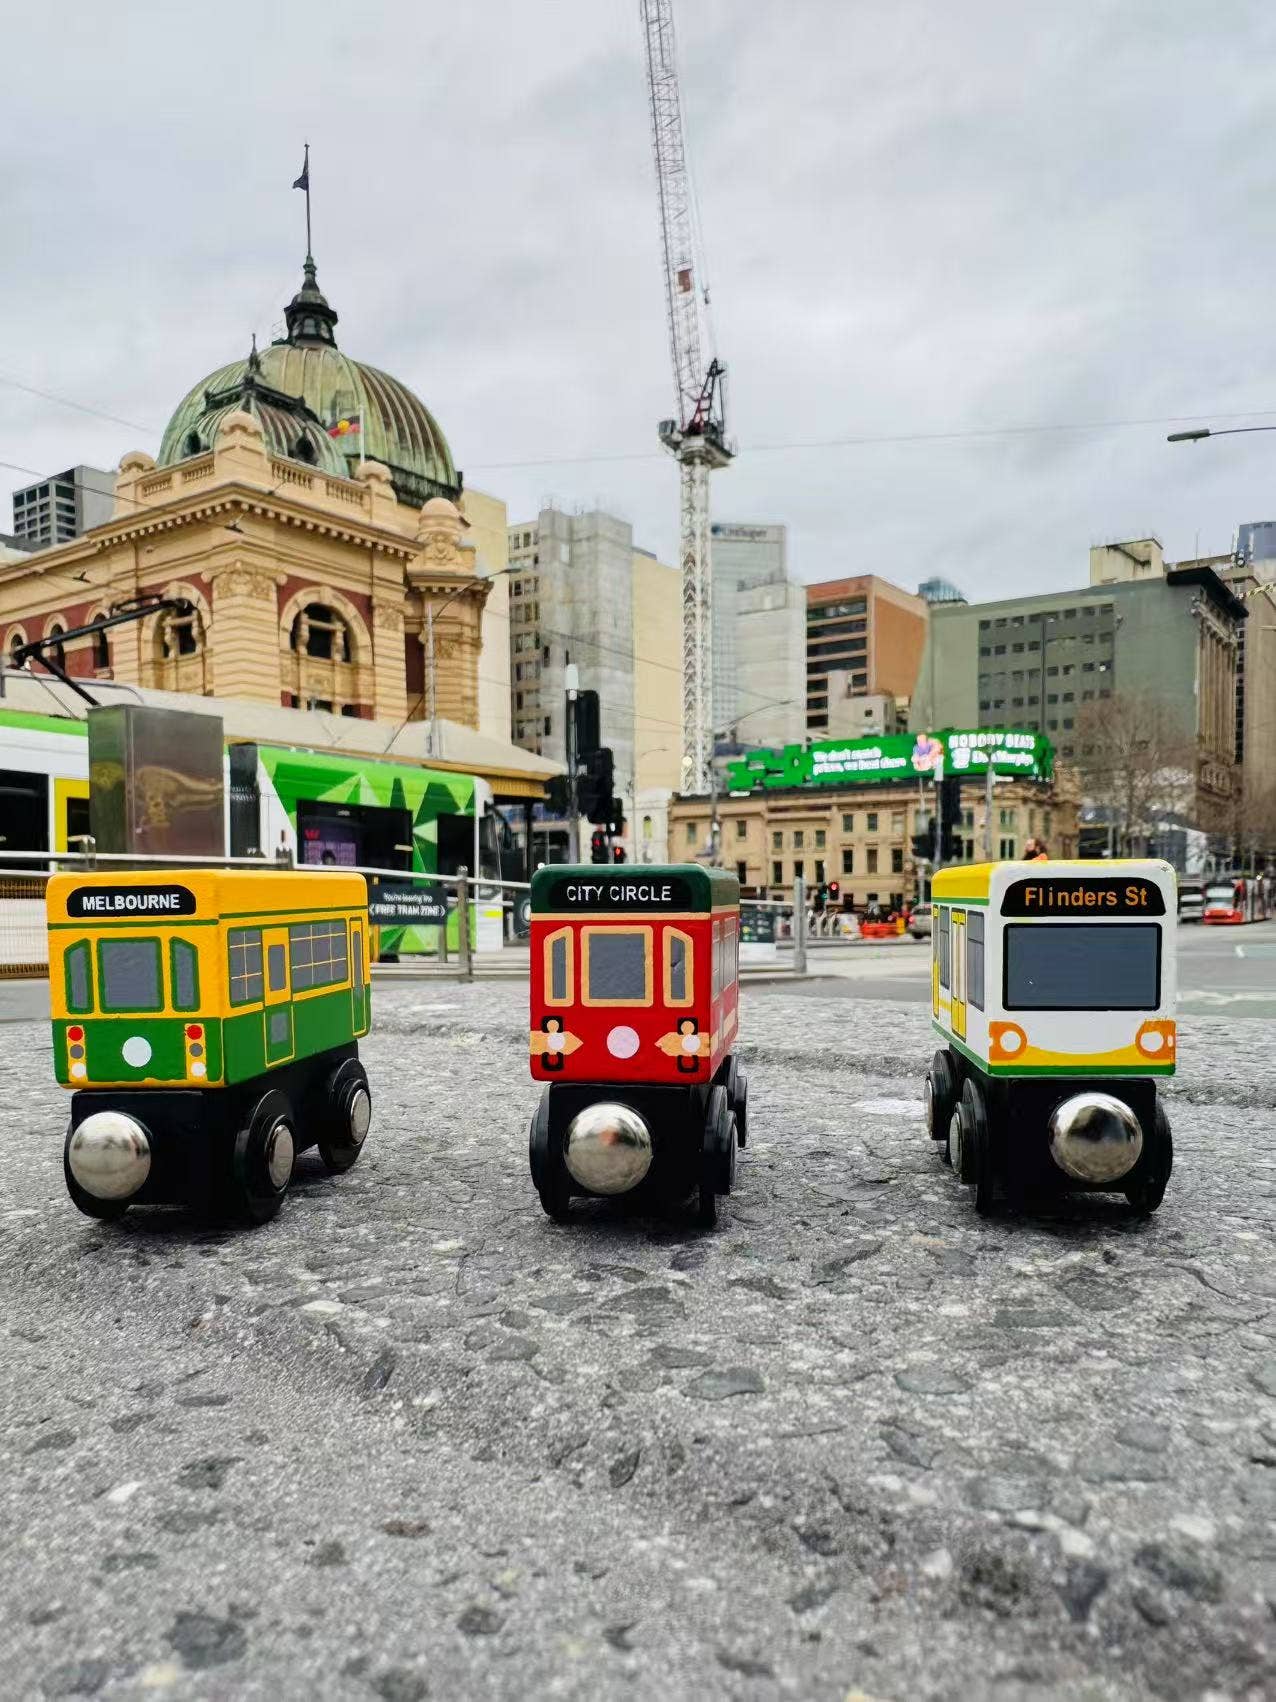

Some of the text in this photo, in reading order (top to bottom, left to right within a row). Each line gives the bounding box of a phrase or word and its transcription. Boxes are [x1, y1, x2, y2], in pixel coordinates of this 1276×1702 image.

[82, 893, 181, 911] MELBOURNE
[566, 885, 672, 902] CITY CIRCLE
[1024, 885, 1148, 907] Flinders St
[375, 903, 440, 917] FREE TRAM ZONE
